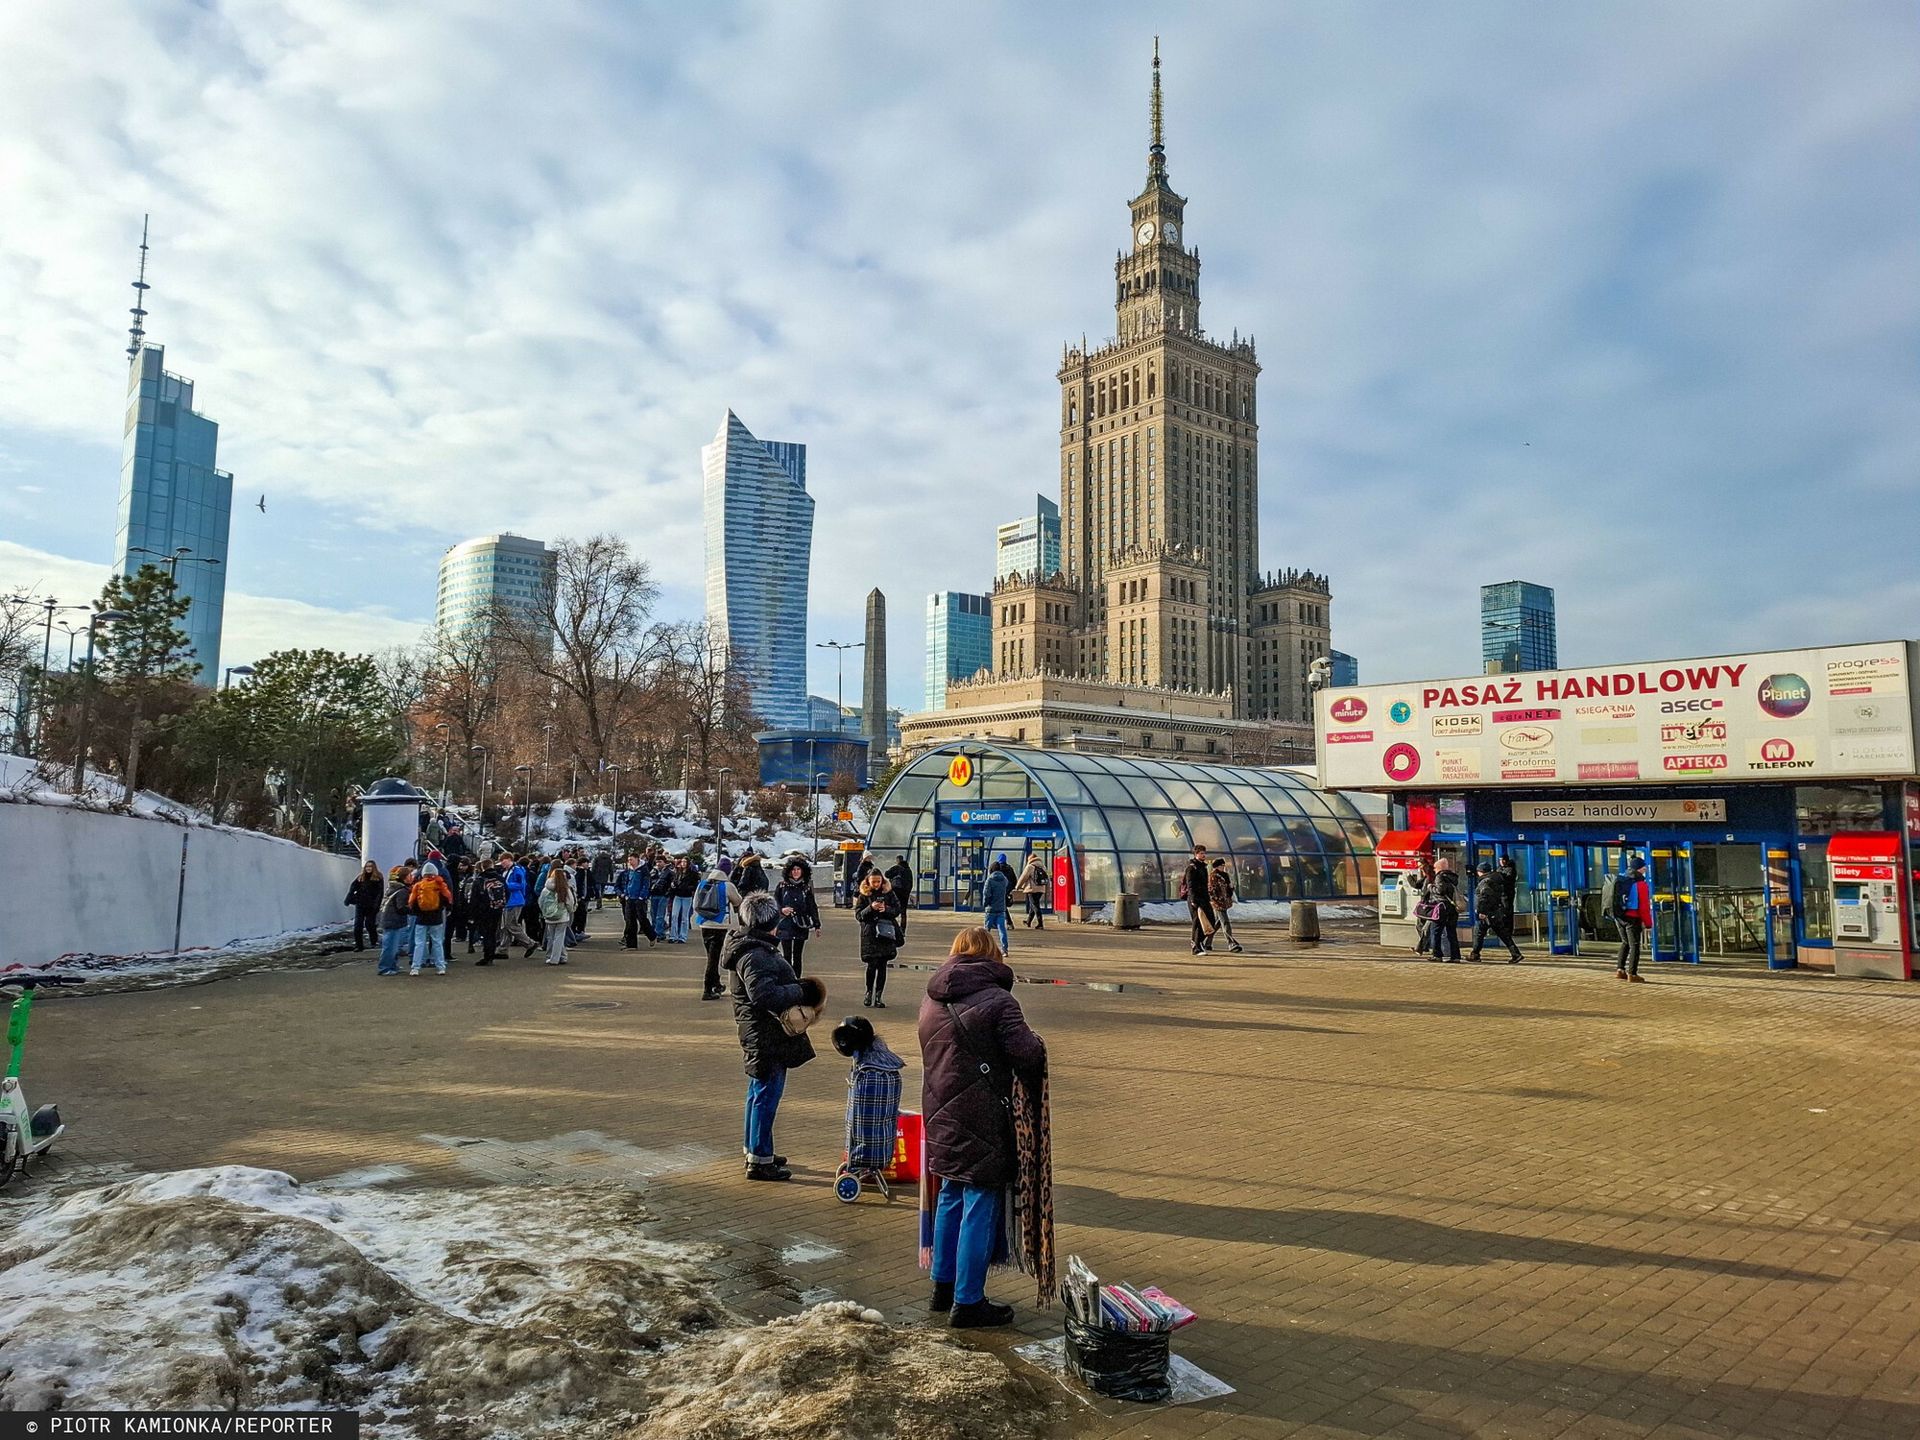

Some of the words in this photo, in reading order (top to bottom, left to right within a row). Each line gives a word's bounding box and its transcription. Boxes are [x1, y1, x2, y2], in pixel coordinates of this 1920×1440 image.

[1827, 658, 1900, 670] progress
[1424, 678, 1522, 708] PASAŻ
[1537, 664, 1747, 700] HANDLOWY
[1762, 687, 1806, 701] Planet
[1344, 700, 1352, 711] 1
[1661, 699, 1712, 713] asec
[1335, 709, 1364, 717] minute
[1435, 716, 1480, 726] KIOSK
[1766, 744, 1789, 759] M
[1508, 758, 1556, 767] Fotoforma
[1667, 756, 1725, 769] APTEKA
[1749, 761, 1815, 769] TELEFONY
[952, 761, 967, 780] M
[971, 811, 1000, 821] Centrum
[1533, 804, 1575, 818] pasaż
[1583, 804, 1657, 818] handlowy
[1382, 859, 1398, 867] Bilety
[1835, 867, 1861, 876] Bilety
